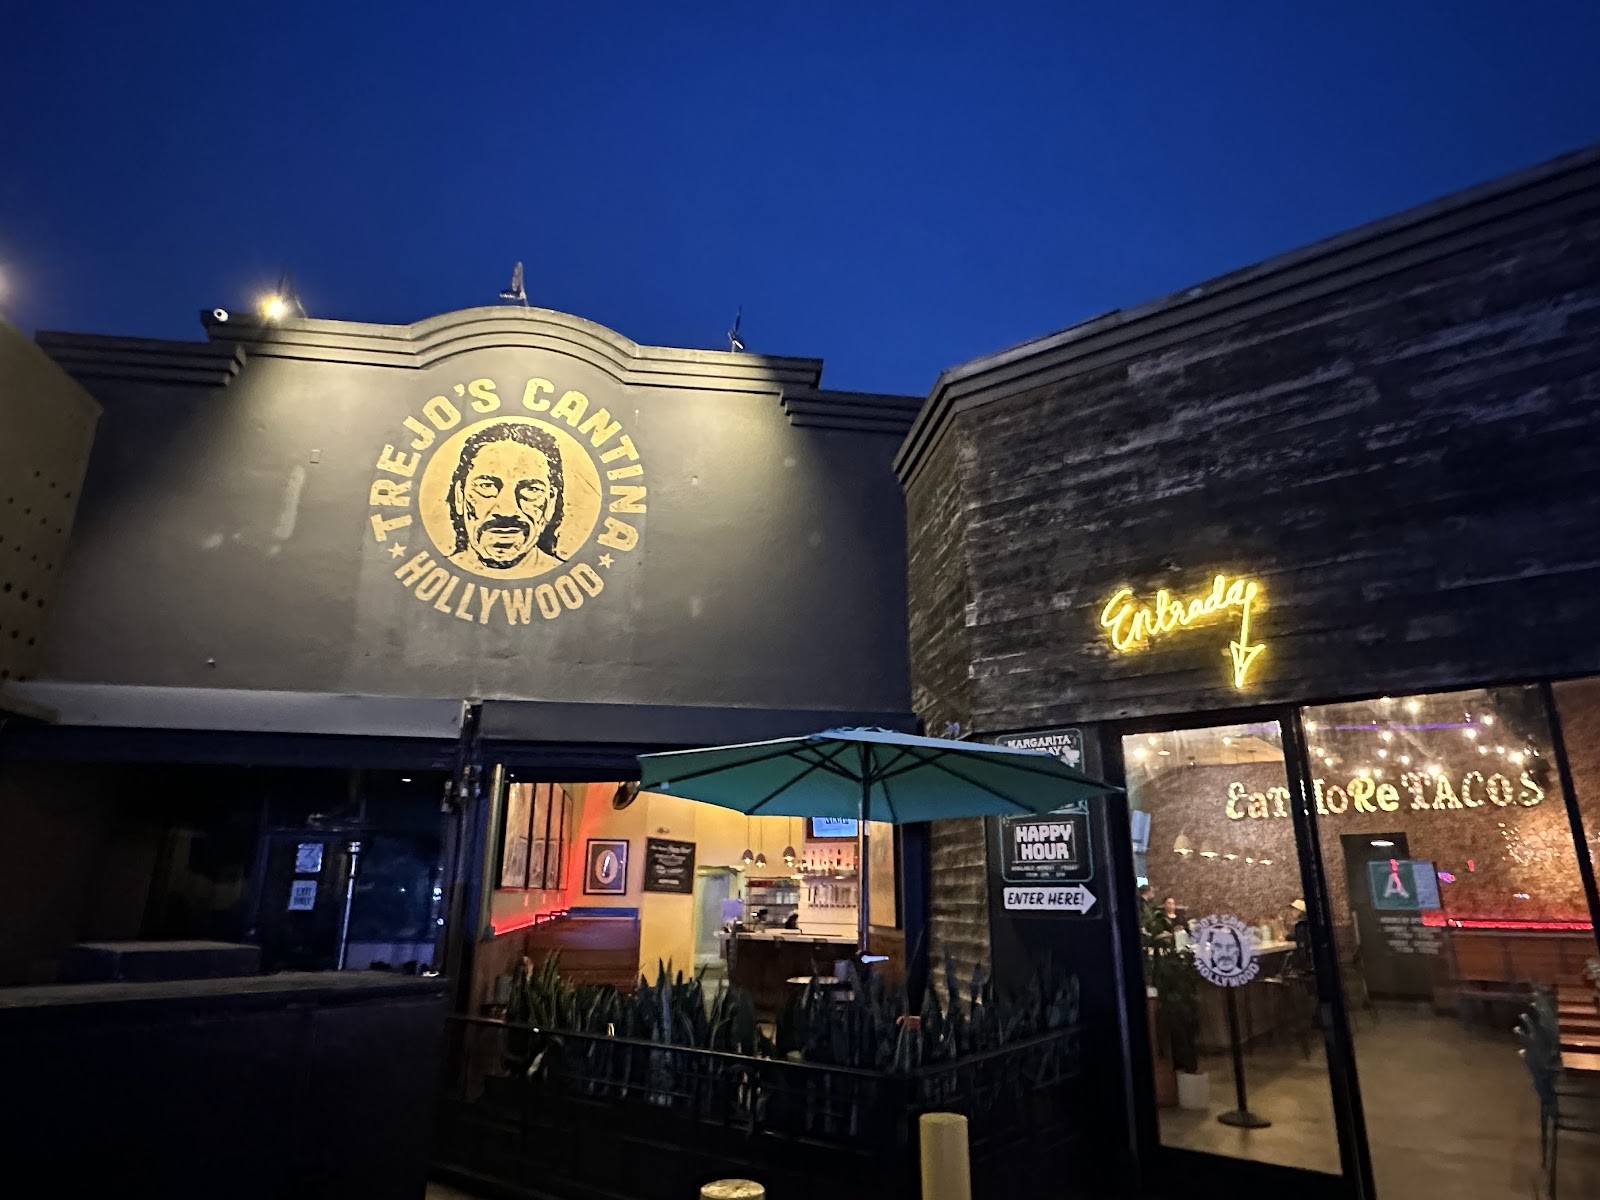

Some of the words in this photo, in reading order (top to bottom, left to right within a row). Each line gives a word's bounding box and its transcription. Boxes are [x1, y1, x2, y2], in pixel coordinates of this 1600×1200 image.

[369, 378, 501, 542] TREJO'S
[522, 377, 647, 551] CANTINA
[394, 551, 604, 625] HOLLYWOOD
[1100, 574, 1259, 651] Entrada
[1007, 734, 1072, 749] MARGARITA
[1401, 770, 1545, 808] TACOS
[1015, 824, 1072, 843] HAPPY
[1021, 842, 1070, 860] HOUR
[1007, 892, 1045, 905] ENTER
[1047, 892, 1085, 905] HERE!
[1193, 958, 1260, 987] HOLLYWOOD
